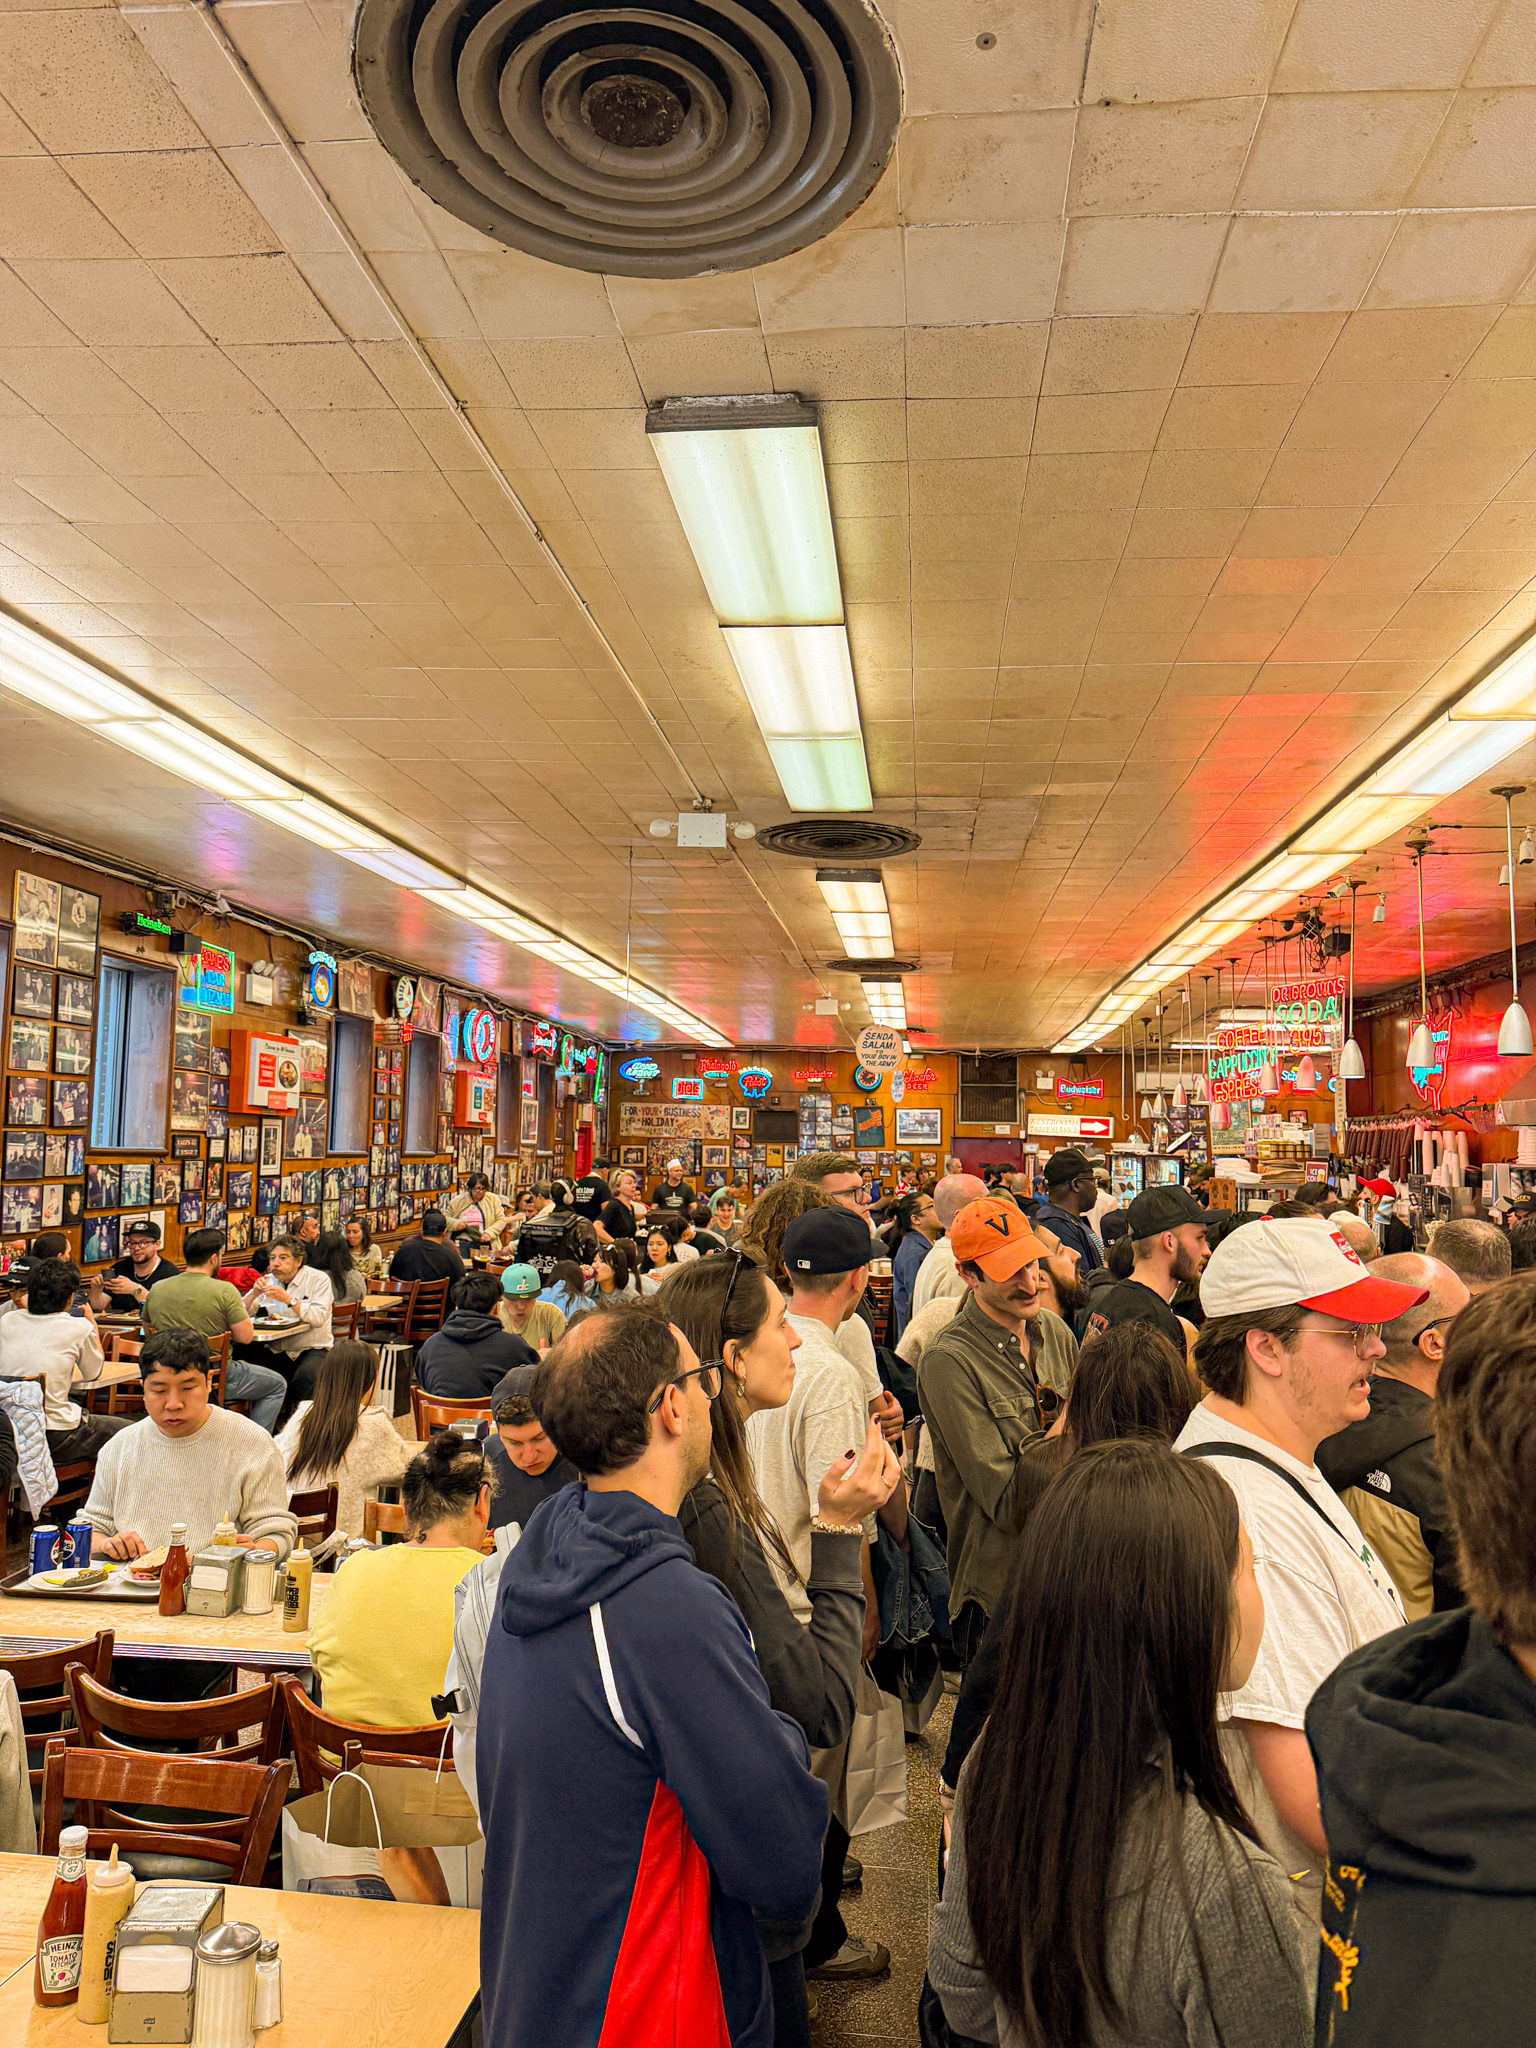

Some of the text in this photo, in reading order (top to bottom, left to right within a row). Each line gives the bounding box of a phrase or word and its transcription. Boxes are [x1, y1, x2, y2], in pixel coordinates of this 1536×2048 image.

[1276, 996, 1340, 1026] SODA
[1216, 1023, 1266, 1051] COFFEE
[862, 1040, 896, 1049] SALAMI
[699, 1058, 737, 1072] Rheingold
[743, 1075, 767, 1087] Pabst
[676, 1081, 700, 1096] Piels
[1060, 1083, 1101, 1094] Budweiser
[624, 1106, 638, 1116] FOR
[641, 1106, 659, 1116] YOUR
[641, 1117, 675, 1127] HOLIDAY
[984, 1213, 1009, 1237] V
[51, 1942, 77, 1952] HEINZ
[50, 1952, 78, 1962] TOMATO
